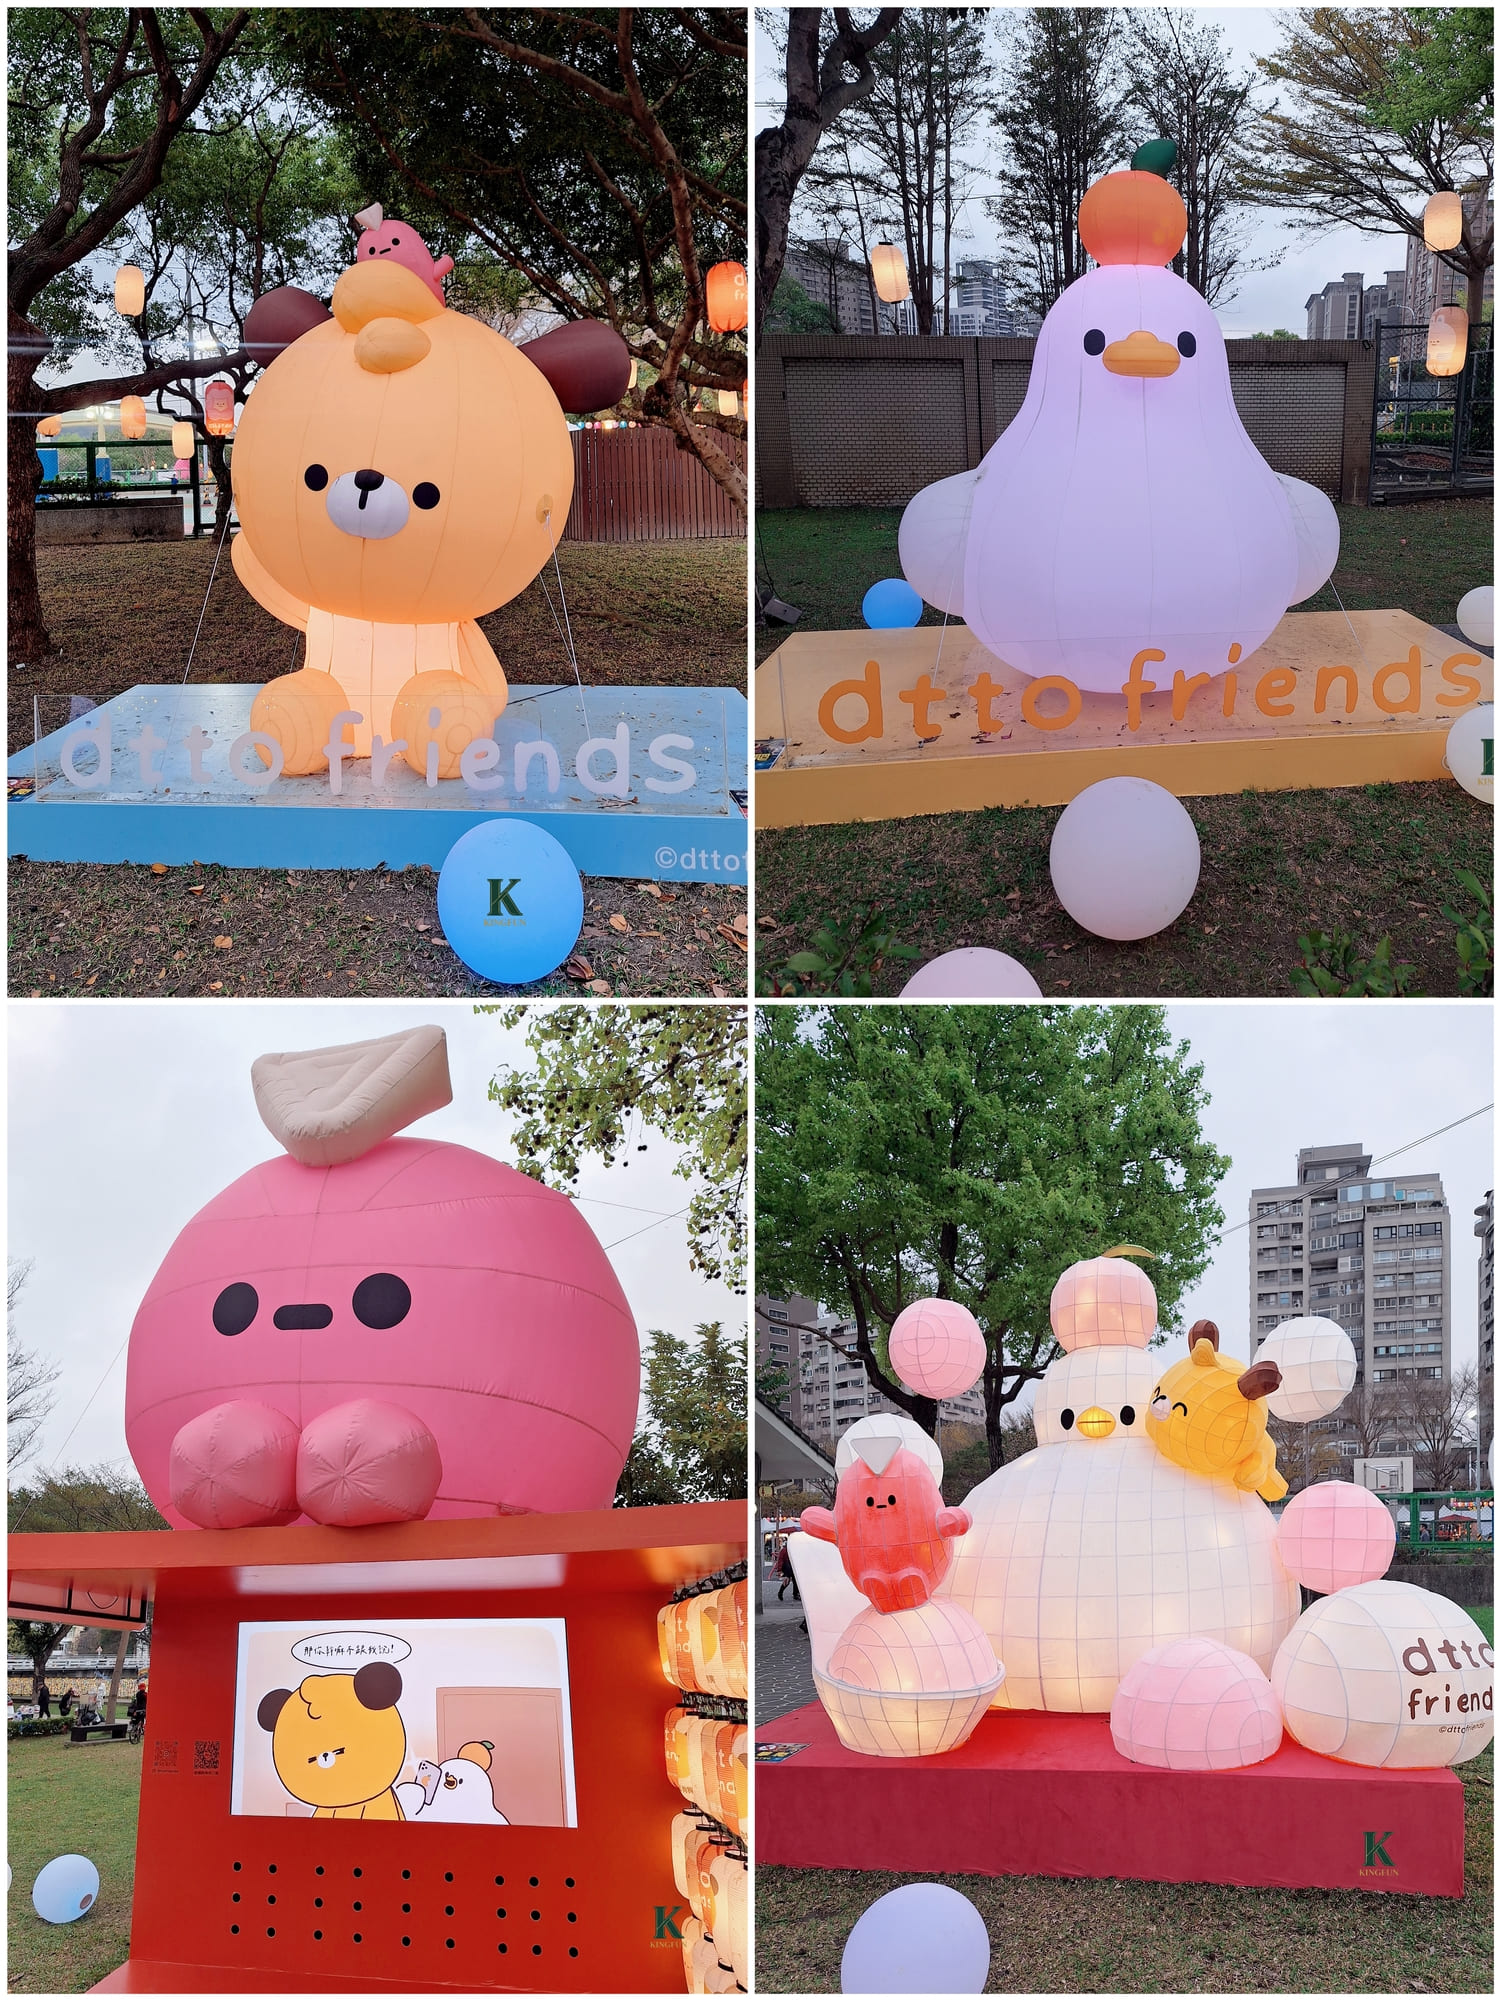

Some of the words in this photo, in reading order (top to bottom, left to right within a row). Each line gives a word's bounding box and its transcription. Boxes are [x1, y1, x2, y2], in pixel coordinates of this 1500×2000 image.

[818, 659, 1083, 744] dtto
[1121, 642, 1482, 732] friends
[60, 711, 285, 789] dtto
[322, 706, 697, 798] friends
[1408, 1683, 1493, 1720] friend
